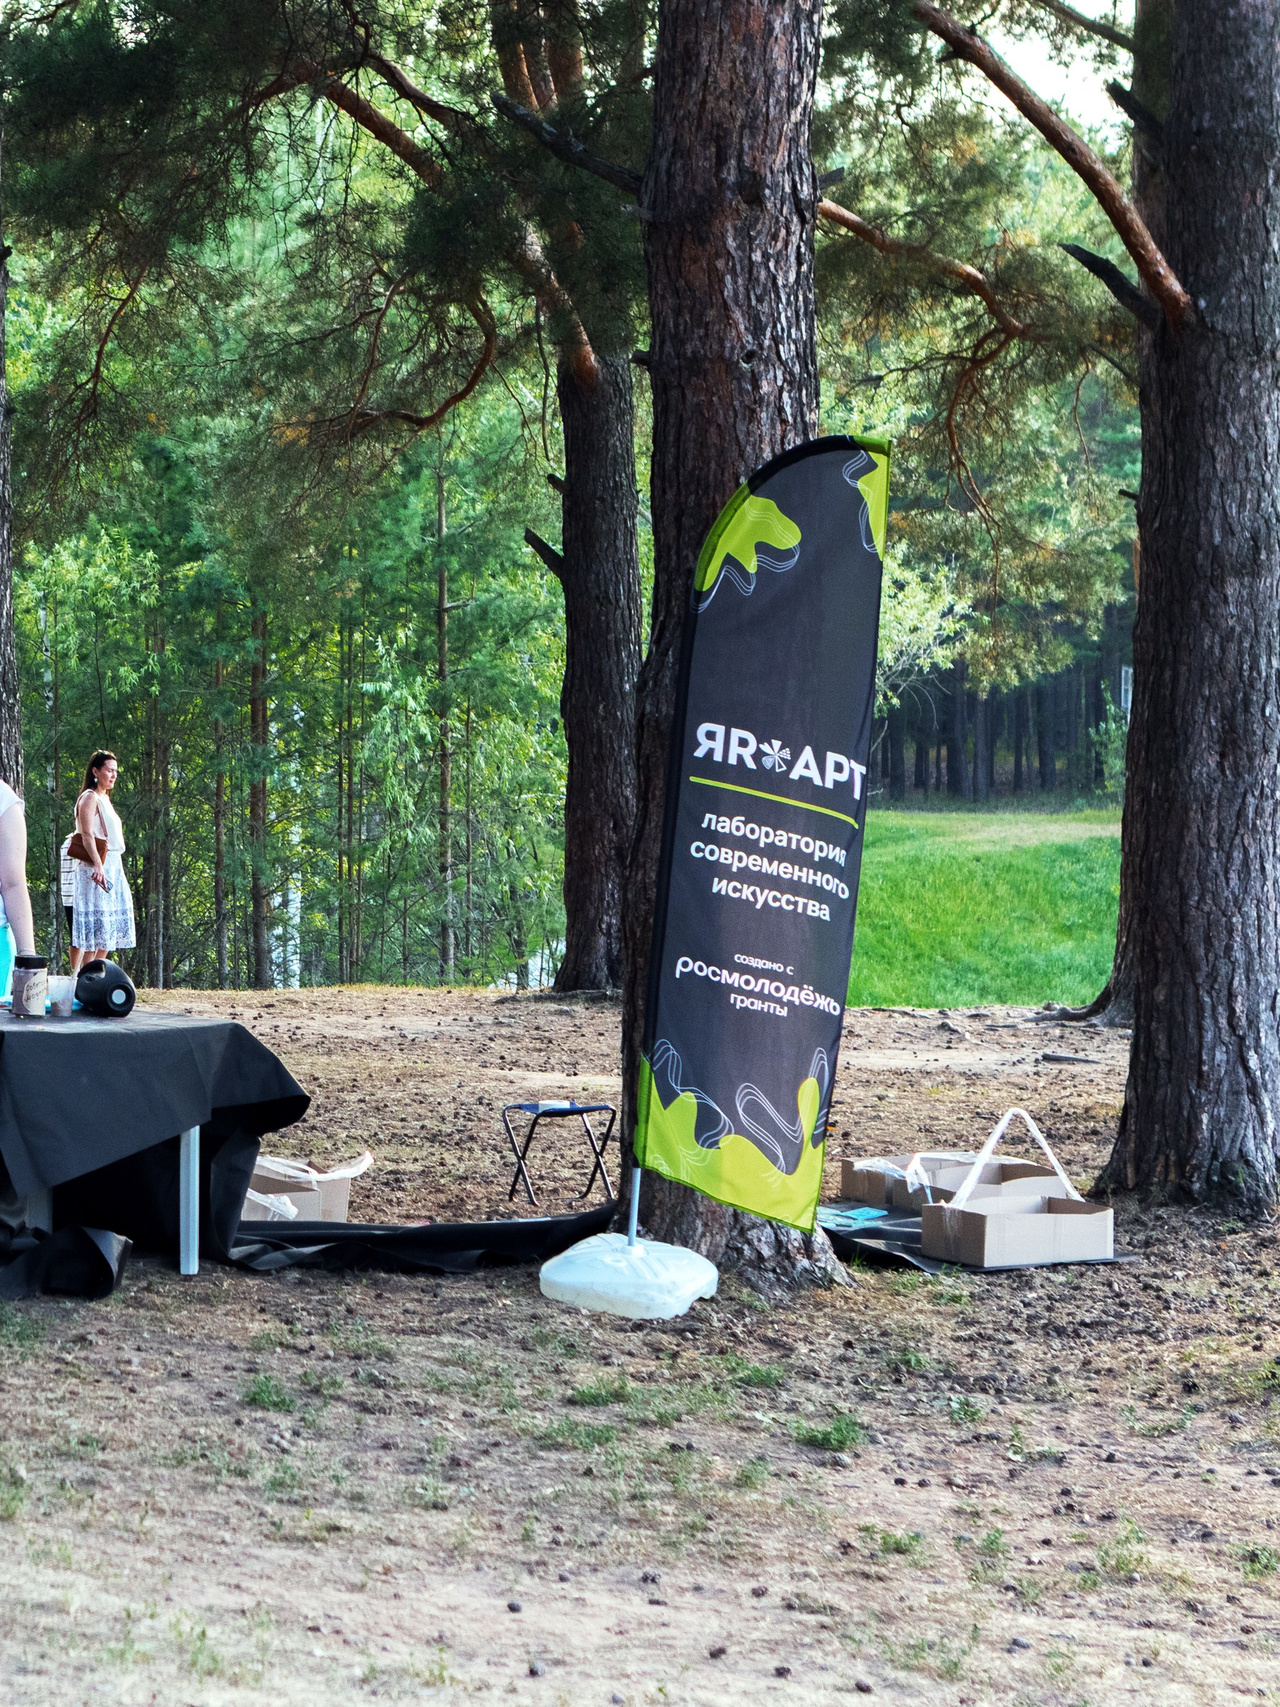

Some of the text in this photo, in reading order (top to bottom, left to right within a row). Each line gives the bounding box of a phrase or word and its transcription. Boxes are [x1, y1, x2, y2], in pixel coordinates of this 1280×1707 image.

[701, 812, 847, 867] лаборатория
[690, 841, 850, 899] современного
[712, 877, 831, 922] искусства
[675, 956, 841, 1016] росмолодёжь
[734, 954, 795, 975] создано с
[730, 993, 788, 1017] гранты
